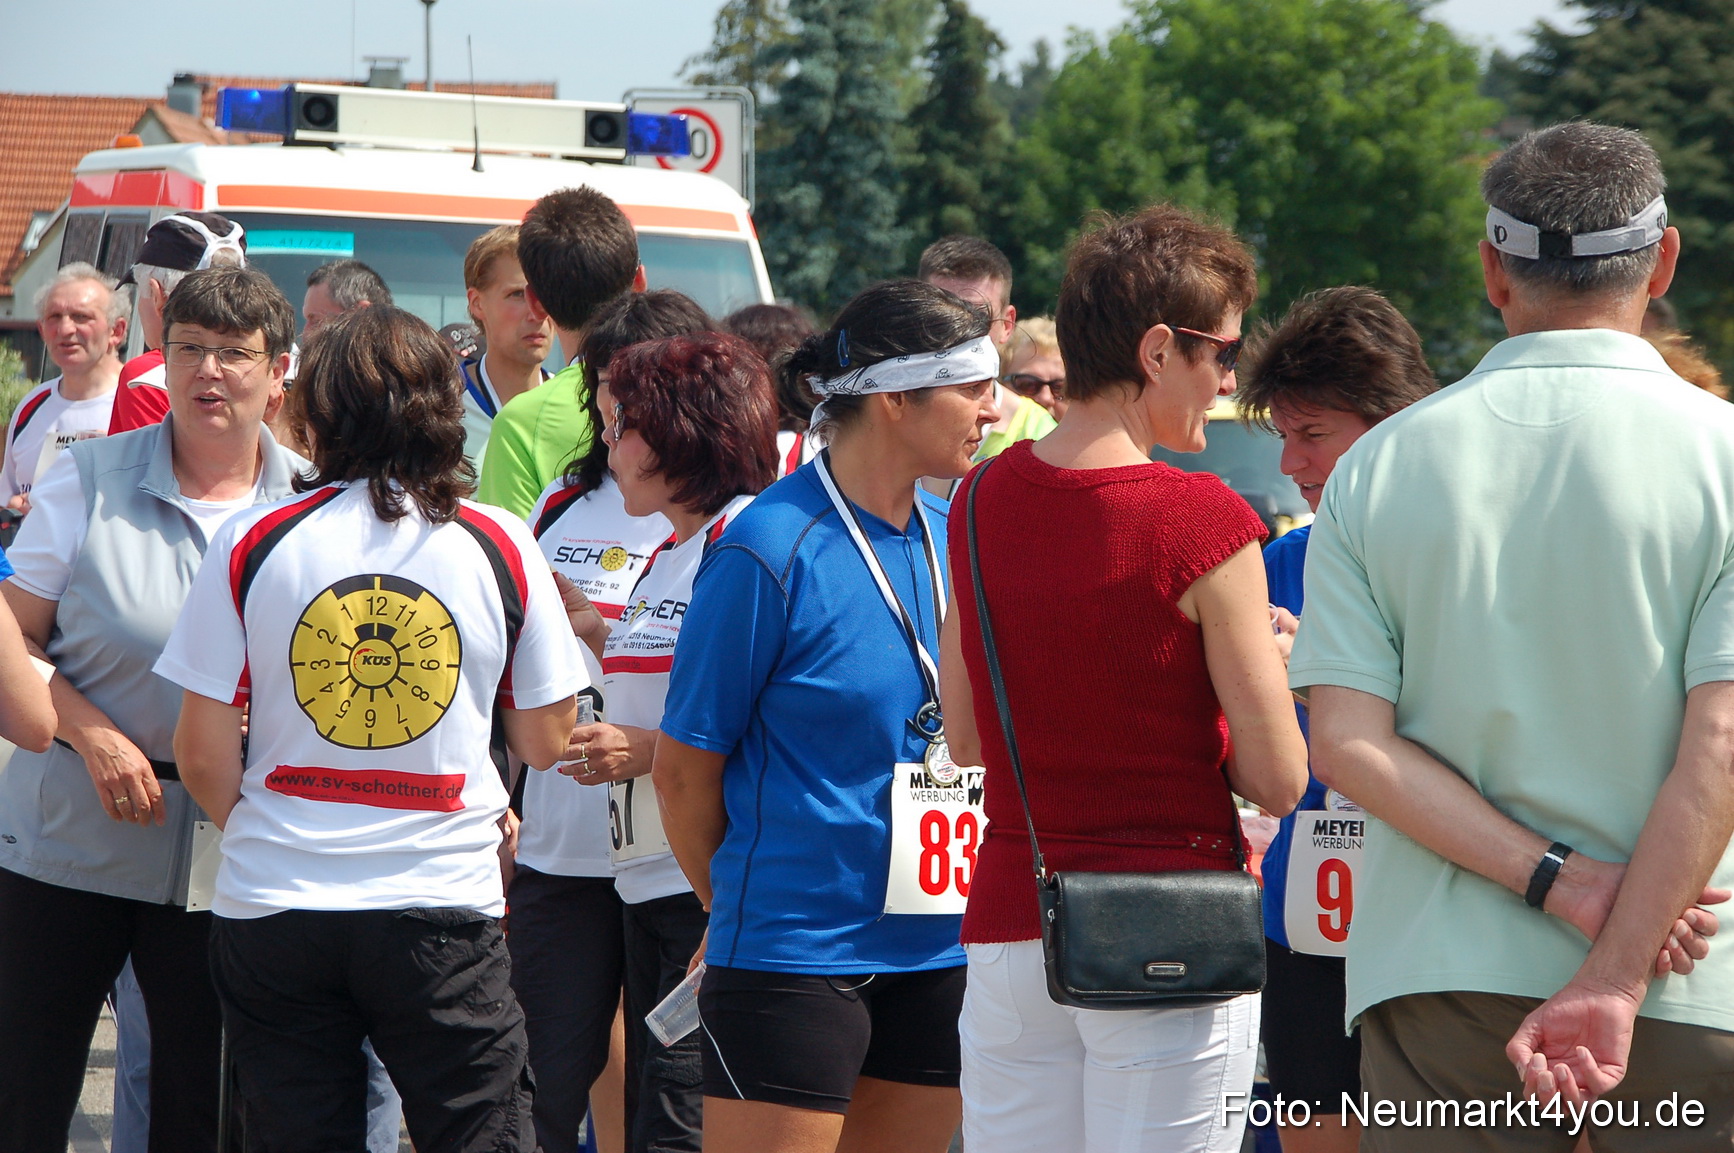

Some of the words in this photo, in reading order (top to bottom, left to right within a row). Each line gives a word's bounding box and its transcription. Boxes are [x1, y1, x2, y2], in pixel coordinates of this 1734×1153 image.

[610, 582, 620, 590] 92
[340, 603, 353, 621] 1
[366, 596, 388, 616] 12
[394, 604, 417, 627] 11
[316, 628, 338, 645] 2
[414, 625, 438, 649] 10
[310, 659, 331, 670] 3
[320, 682, 334, 694] 4
[411, 685, 430, 701] 8
[395, 704, 408, 724] 7
[270, 773, 463, 800] www.sv-schottner.de
[910, 773, 964, 789] MER
[911, 790, 965, 802] WERBUNG
[1312, 837, 1364, 849] WERBUN
[919, 809, 978, 897] 83
